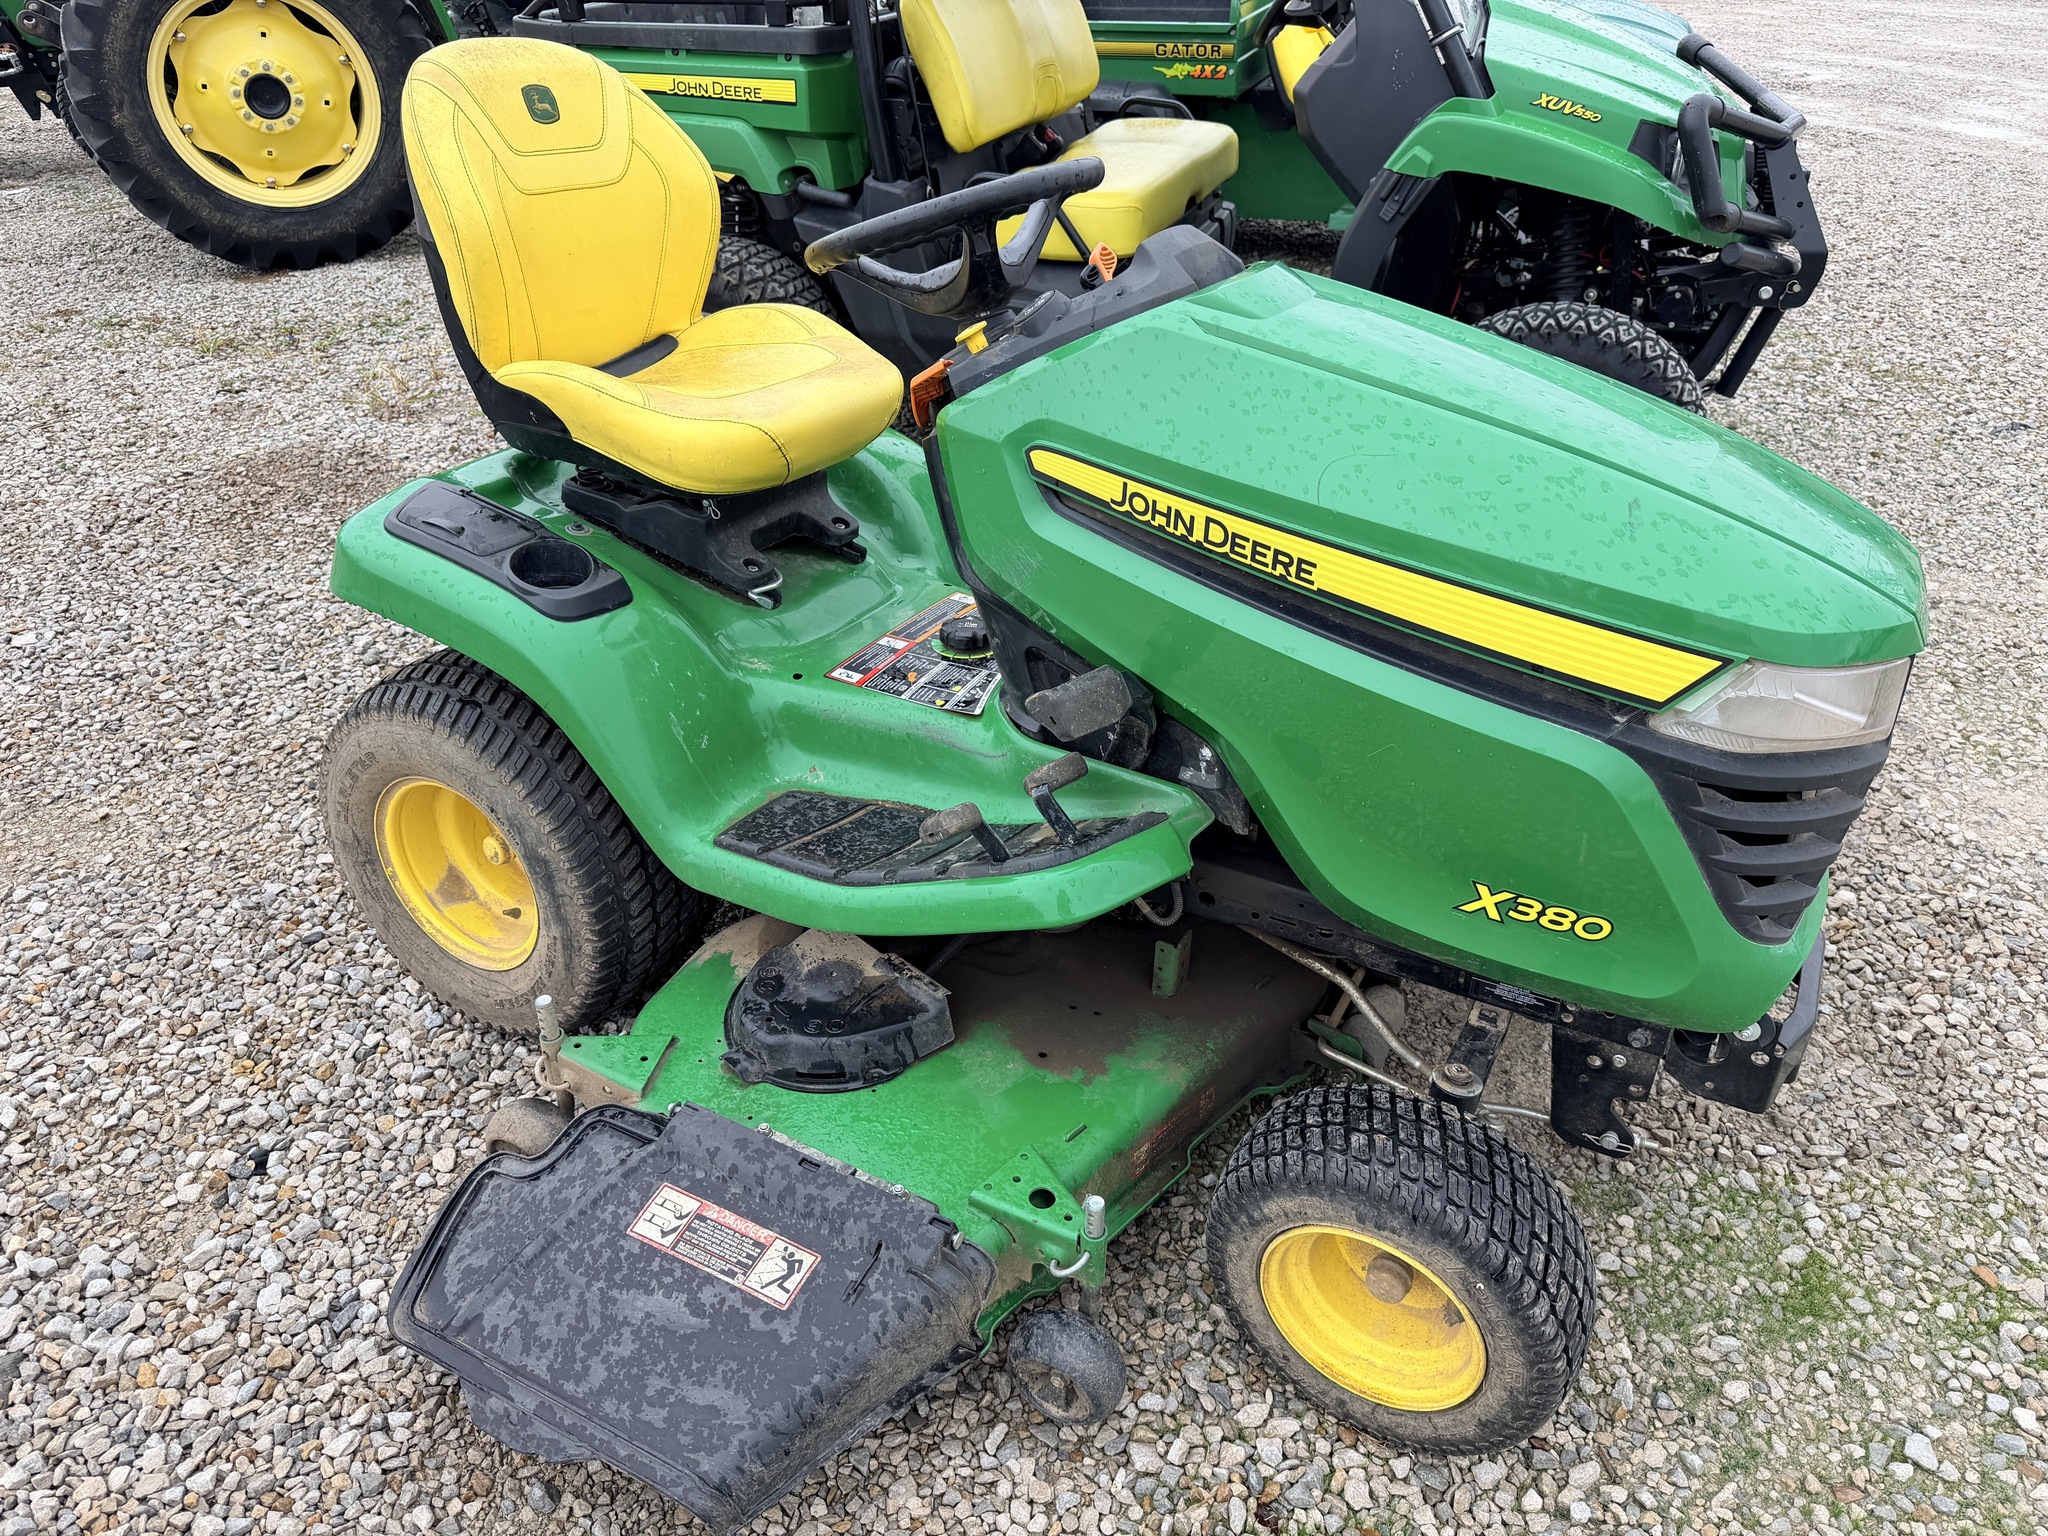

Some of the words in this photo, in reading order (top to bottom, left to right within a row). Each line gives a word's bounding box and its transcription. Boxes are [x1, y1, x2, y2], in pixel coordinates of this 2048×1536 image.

[1155, 43, 1222, 57] GATOR
[1189, 64, 1228, 79] 4X2
[668, 78, 709, 95] JOHN
[712, 81, 762, 99] DEERE
[1110, 482, 1195, 538] JOHN
[1203, 516, 1317, 586] DEERE
[1452, 880, 1614, 941] X380
[704, 1218, 735, 1236] ROTATING
[733, 1232, 754, 1245] BLADE
[716, 1209, 770, 1241] DANGER
[694, 1229, 721, 1245] THROWN
[719, 1241, 747, 1257] OBJECTS
